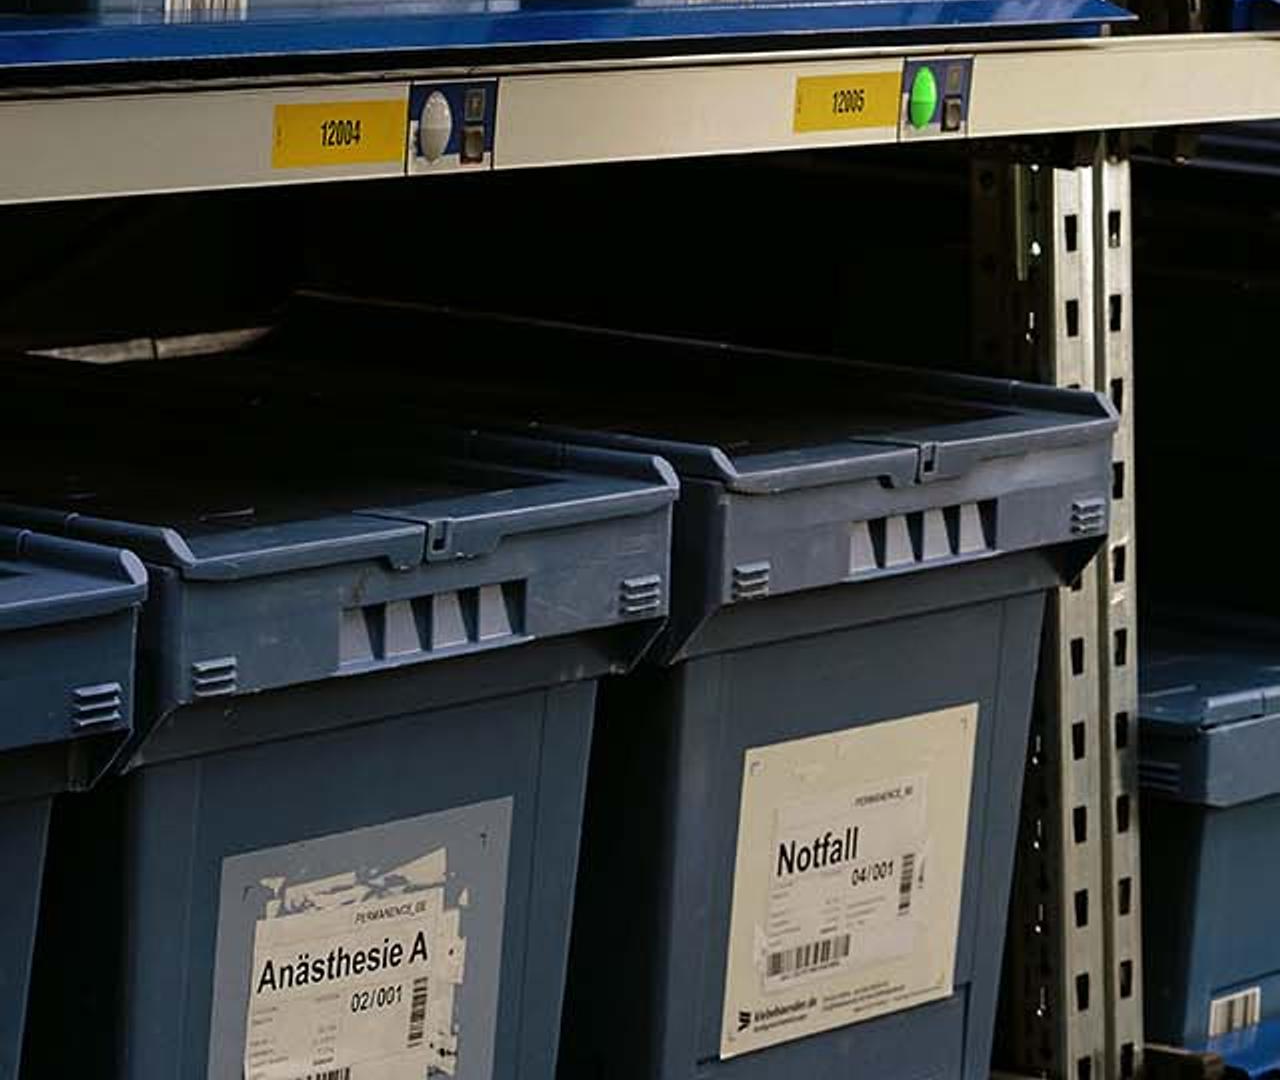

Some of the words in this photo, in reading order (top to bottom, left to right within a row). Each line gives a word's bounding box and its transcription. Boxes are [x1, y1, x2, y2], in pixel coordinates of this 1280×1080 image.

[832, 88, 866, 115] 12005
[320, 119, 362, 147] 12004
[776, 825, 860, 877] Notfall
[851, 860, 894, 887] 04/001
[256, 938, 404, 994] Anästhesie
[408, 930, 428, 964] A
[350, 984, 403, 1013] 02/001
